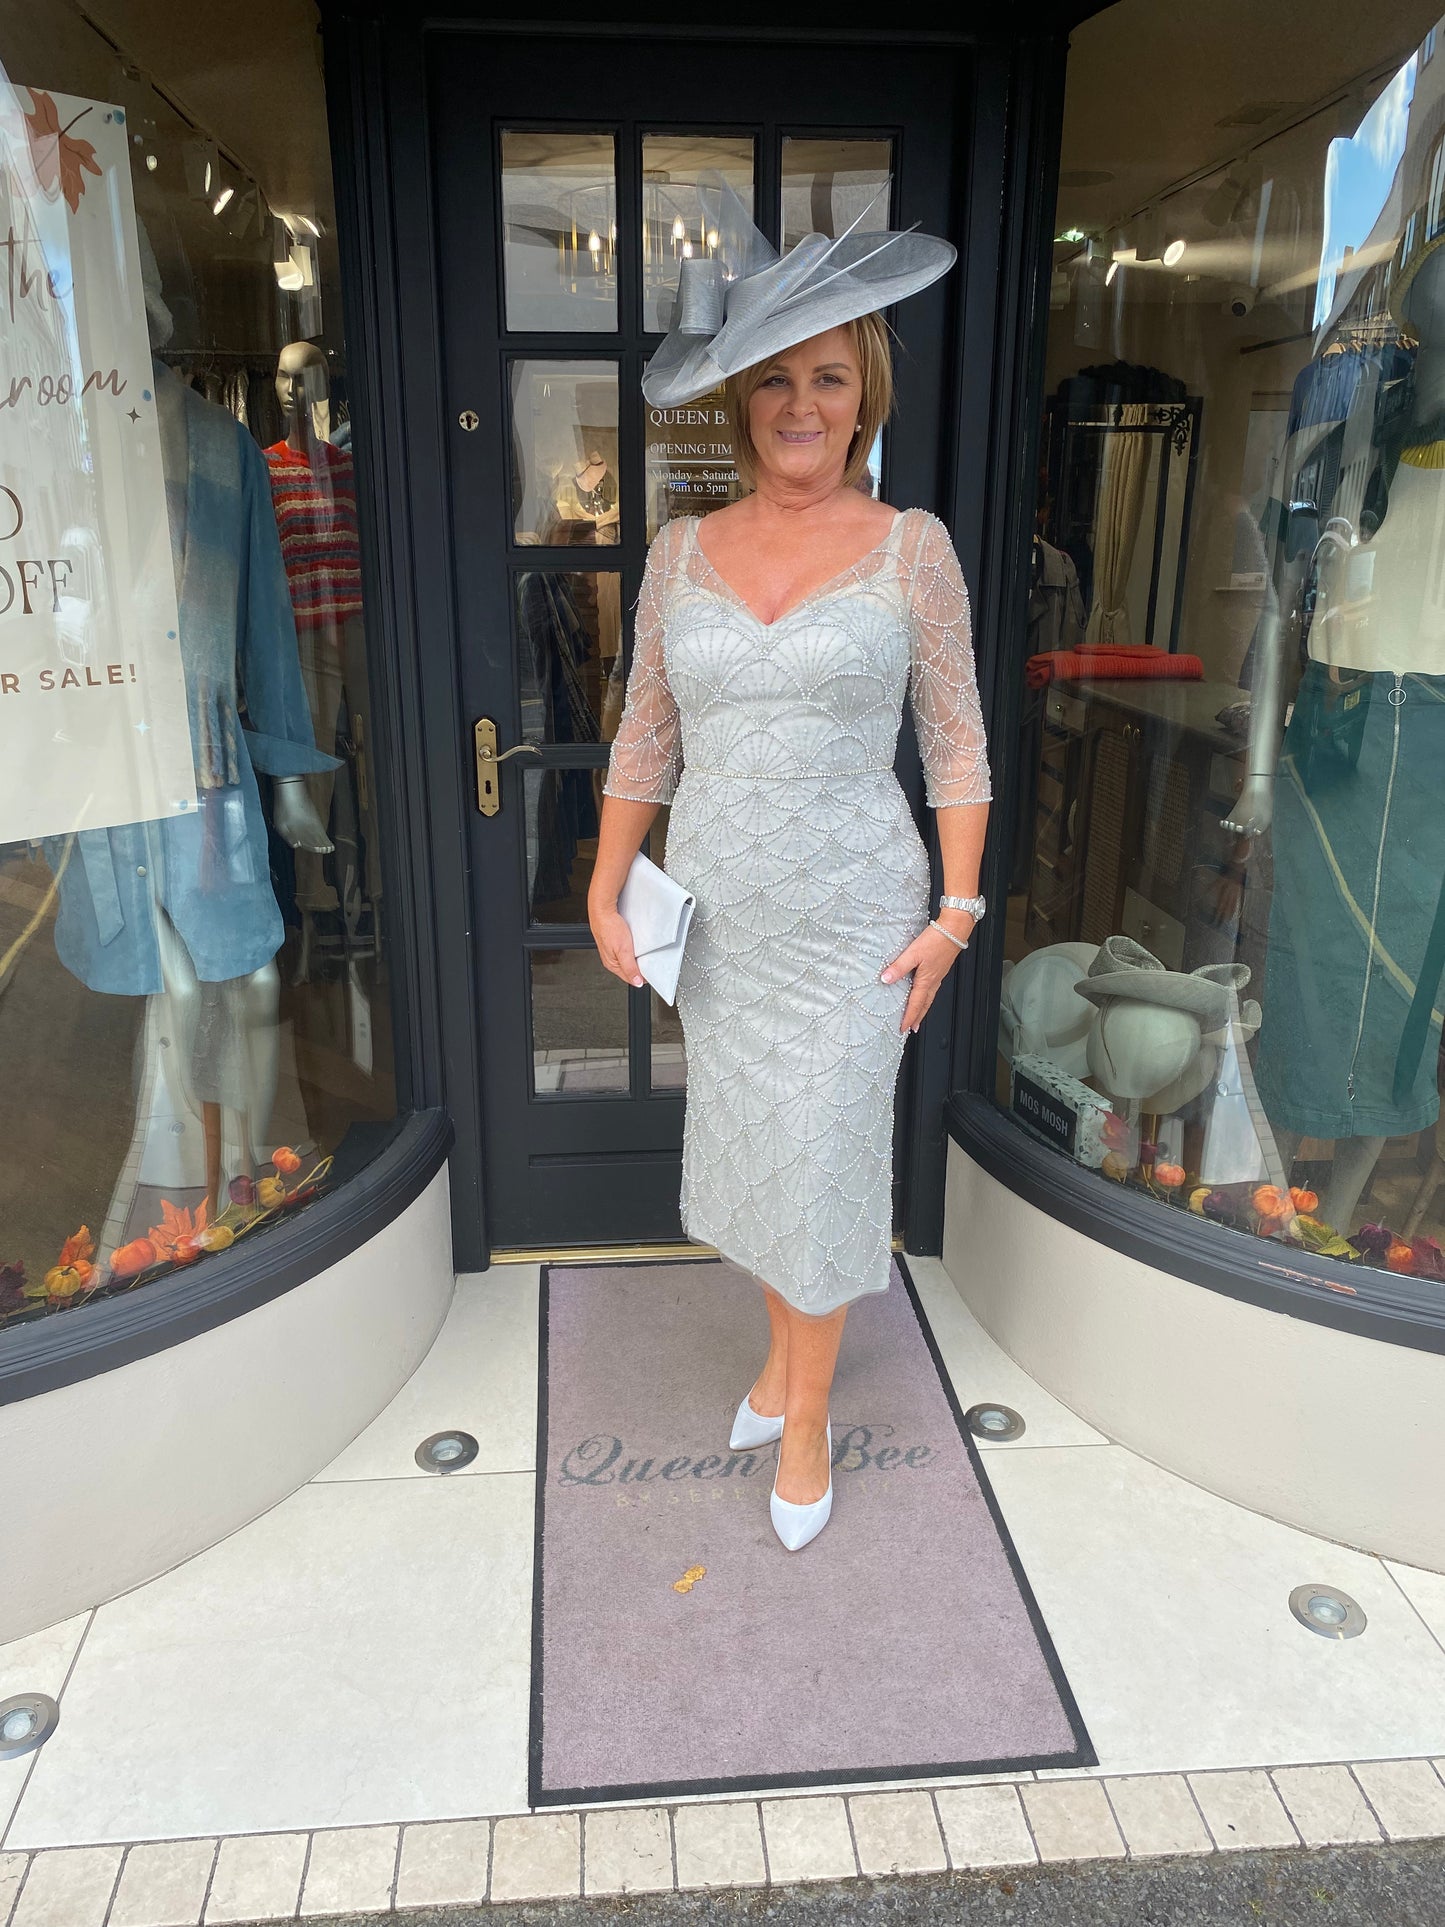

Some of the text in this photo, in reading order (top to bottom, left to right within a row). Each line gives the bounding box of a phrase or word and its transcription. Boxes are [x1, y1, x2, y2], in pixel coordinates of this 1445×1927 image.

[650, 409, 730, 427] QUEEN B
[650, 443, 732, 455] OPENING TIM
[650, 469, 692, 483] Monday
[702, 469, 740, 480] Saturda
[670, 482, 728, 495] 9am to 5pm
[39, 664, 136, 690] SALE!
[1020, 1089, 1068, 1137] MOS MOSH
[558, 1423, 941, 1487] Queen Bee
